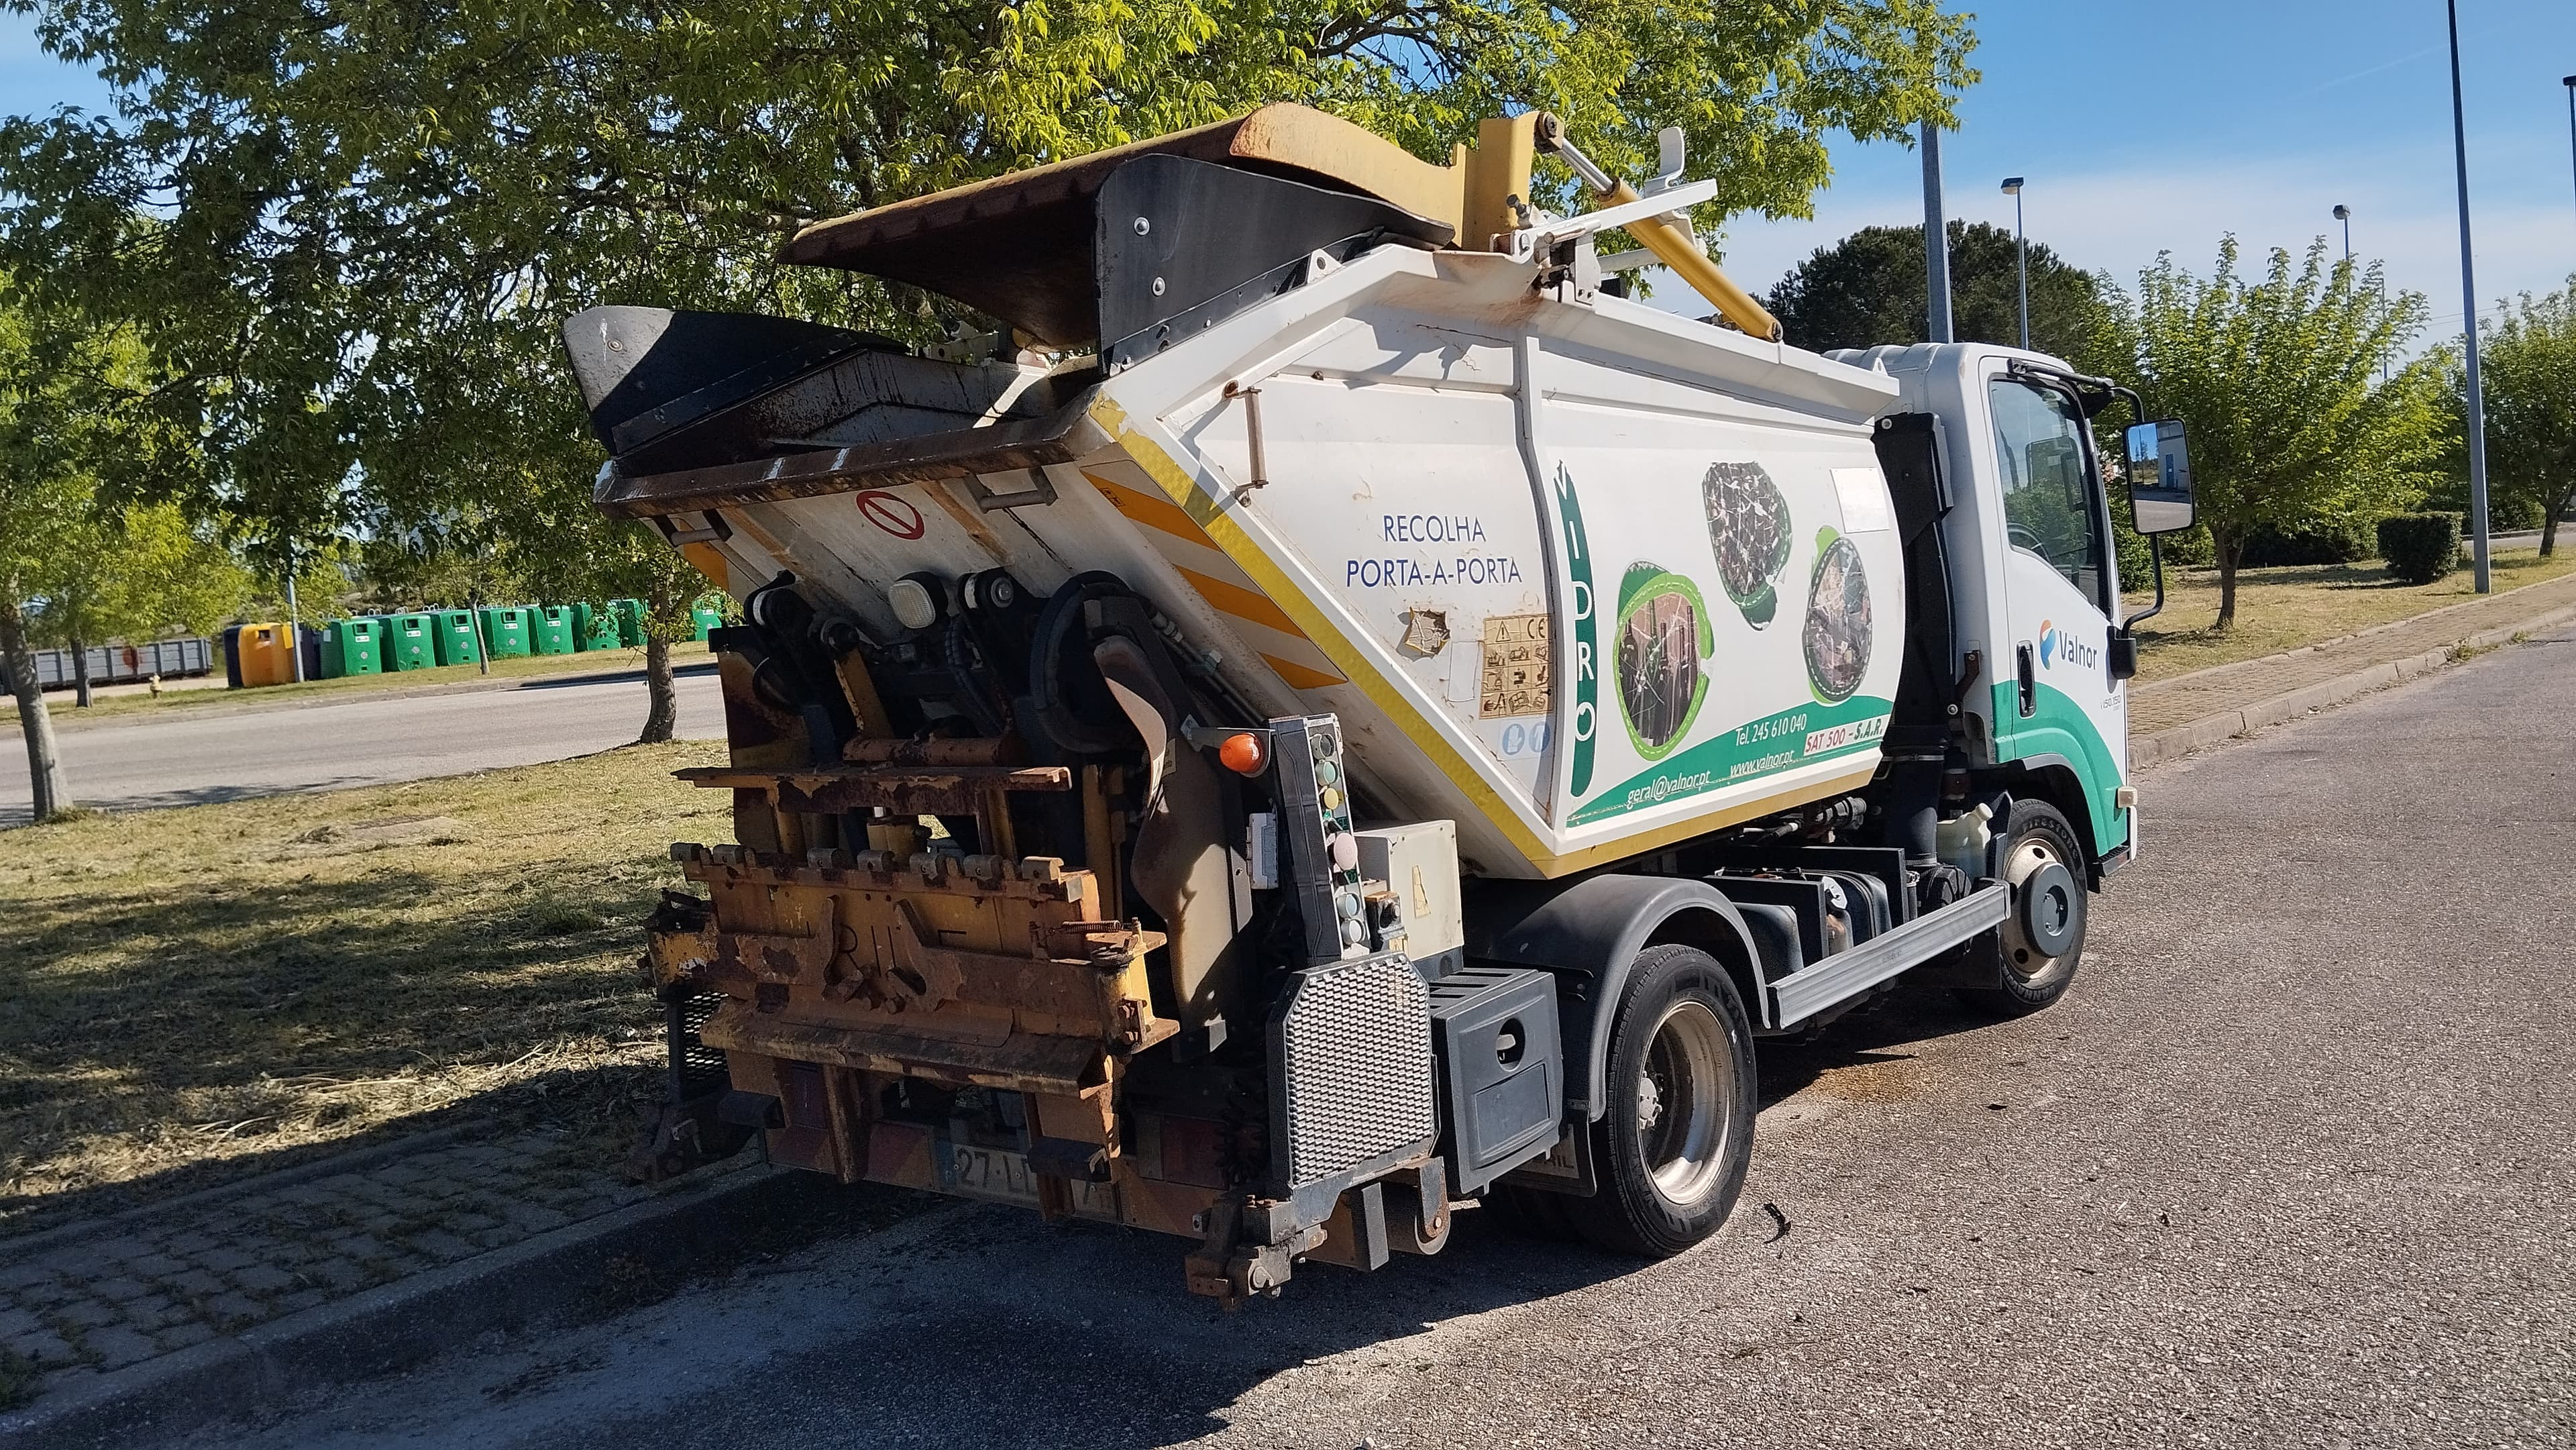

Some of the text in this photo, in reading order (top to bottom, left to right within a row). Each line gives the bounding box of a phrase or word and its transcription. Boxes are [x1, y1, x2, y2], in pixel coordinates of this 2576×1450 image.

[1383, 515, 1487, 542] RECOLHA
[1347, 558, 1522, 587] PORTA-A-PORTA
[1552, 463, 1596, 741] VIDRO
[2059, 630, 2097, 670] Valnor
[1735, 713, 1807, 746] Tel. 245 610 040
[1806, 734, 1824, 752] SAT
[1826, 728, 1845, 747] 500
[1730, 749, 1794, 776] www.valnor.pt
[1626, 770, 1711, 809] geral@valnor.pt
